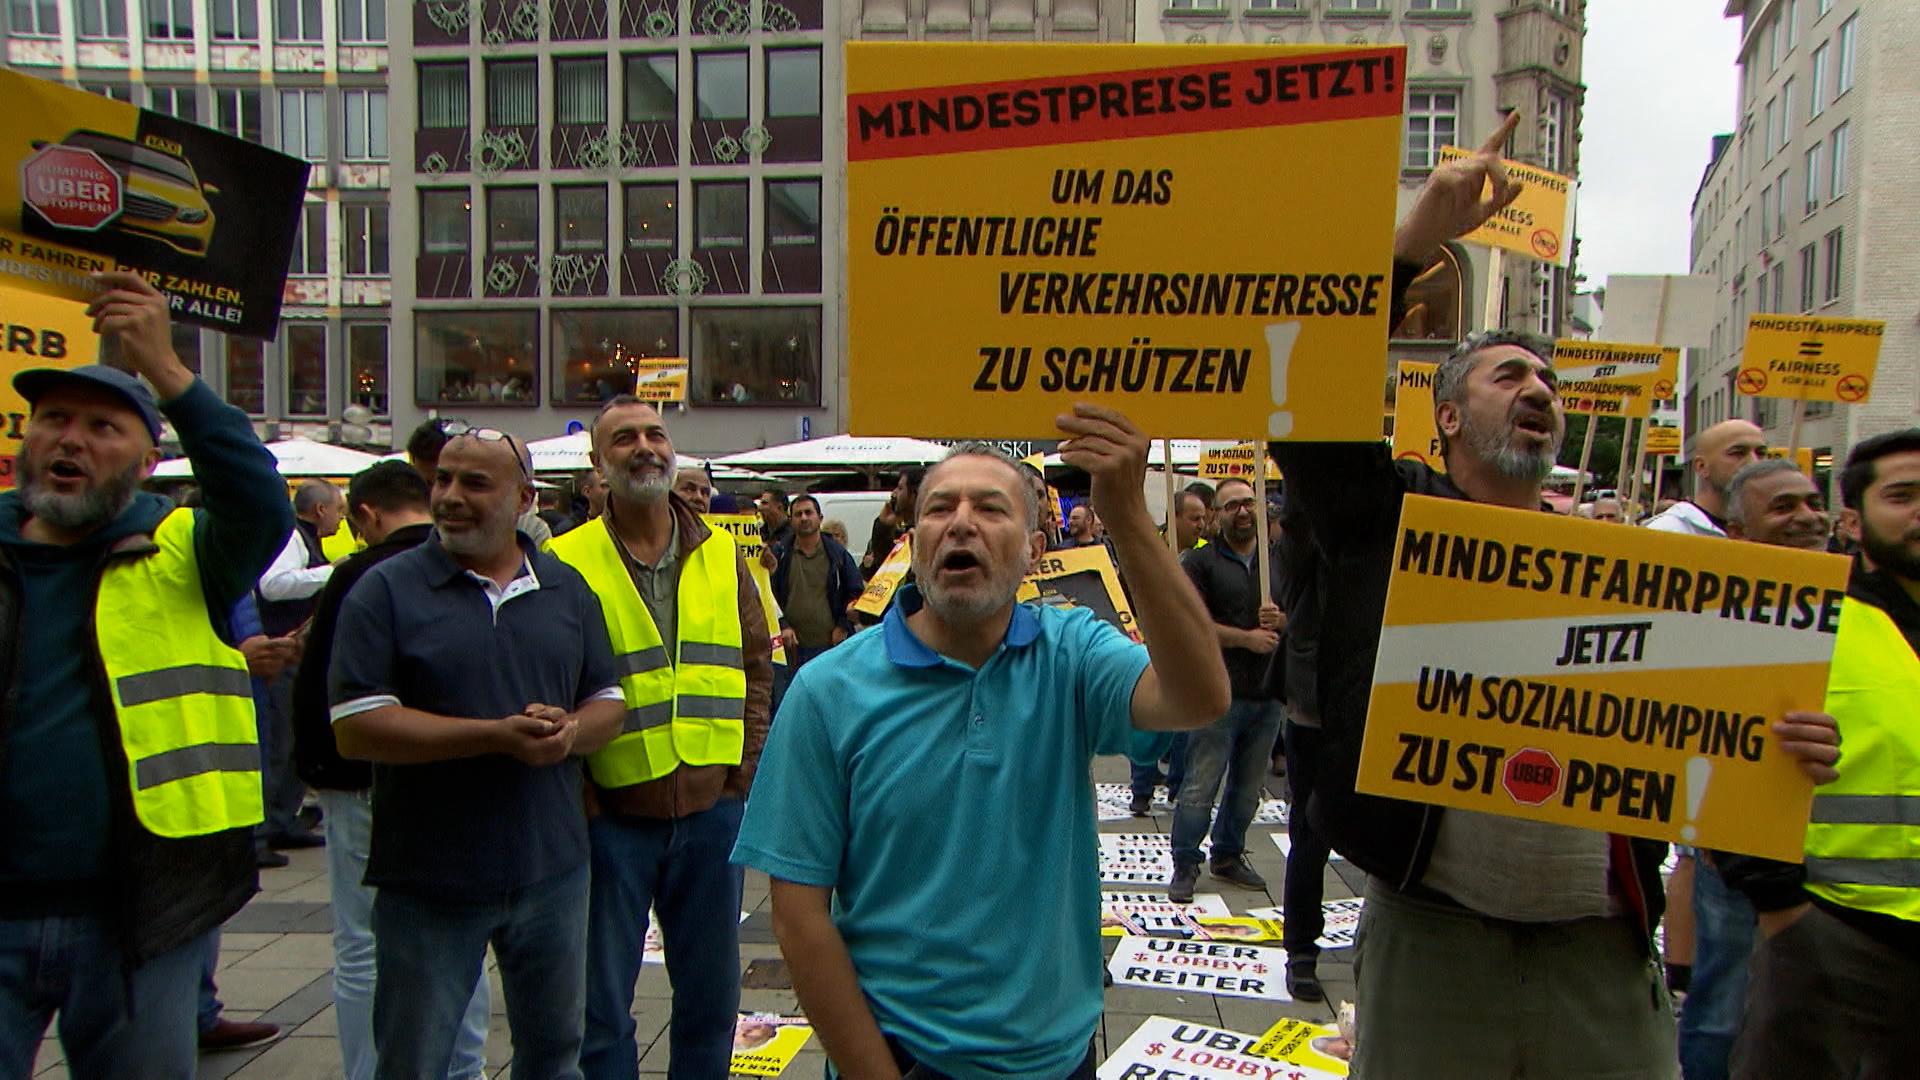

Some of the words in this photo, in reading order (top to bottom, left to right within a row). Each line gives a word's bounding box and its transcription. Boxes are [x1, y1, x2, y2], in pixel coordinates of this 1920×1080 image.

[857, 71, 1231, 142] MINDESTPREISE
[1245, 55, 1395, 105] JETZT!
[39, 177, 111, 202] UBER
[1052, 169, 1103, 204] UM
[1112, 169, 1173, 205] DAS
[874, 207, 1102, 256] ÖFFENTLICHE
[21, 242, 105, 272] FAHREN
[1000, 273, 1384, 316] VERKEHRSINTERESSE
[188, 300, 242, 324] ALLE!
[1749, 320, 1885, 336] MINDESTFAHRPREIS
[972, 347, 1031, 392] ZU
[1040, 338, 1251, 393] SCHÜTZEN
[1554, 347, 1663, 365] MINDESTFAHRPREISE
[1768, 359, 1841, 376] FAIRNESS
[1399, 370, 1432, 388] MIN
[1400, 528, 1843, 633] MINDESTFAHRPREISE
[1555, 621, 1652, 666] JETZT
[1417, 667, 1473, 717] UM
[1477, 677, 1765, 762] SOZIALDUMPING
[1392, 733, 1449, 786] ZU
[1148, 939, 1259, 960] UBER
[1157, 954, 1247, 972] LOBBY
[1125, 966, 1267, 994] REITER
[1171, 1047, 1284, 1080] LOBBY
